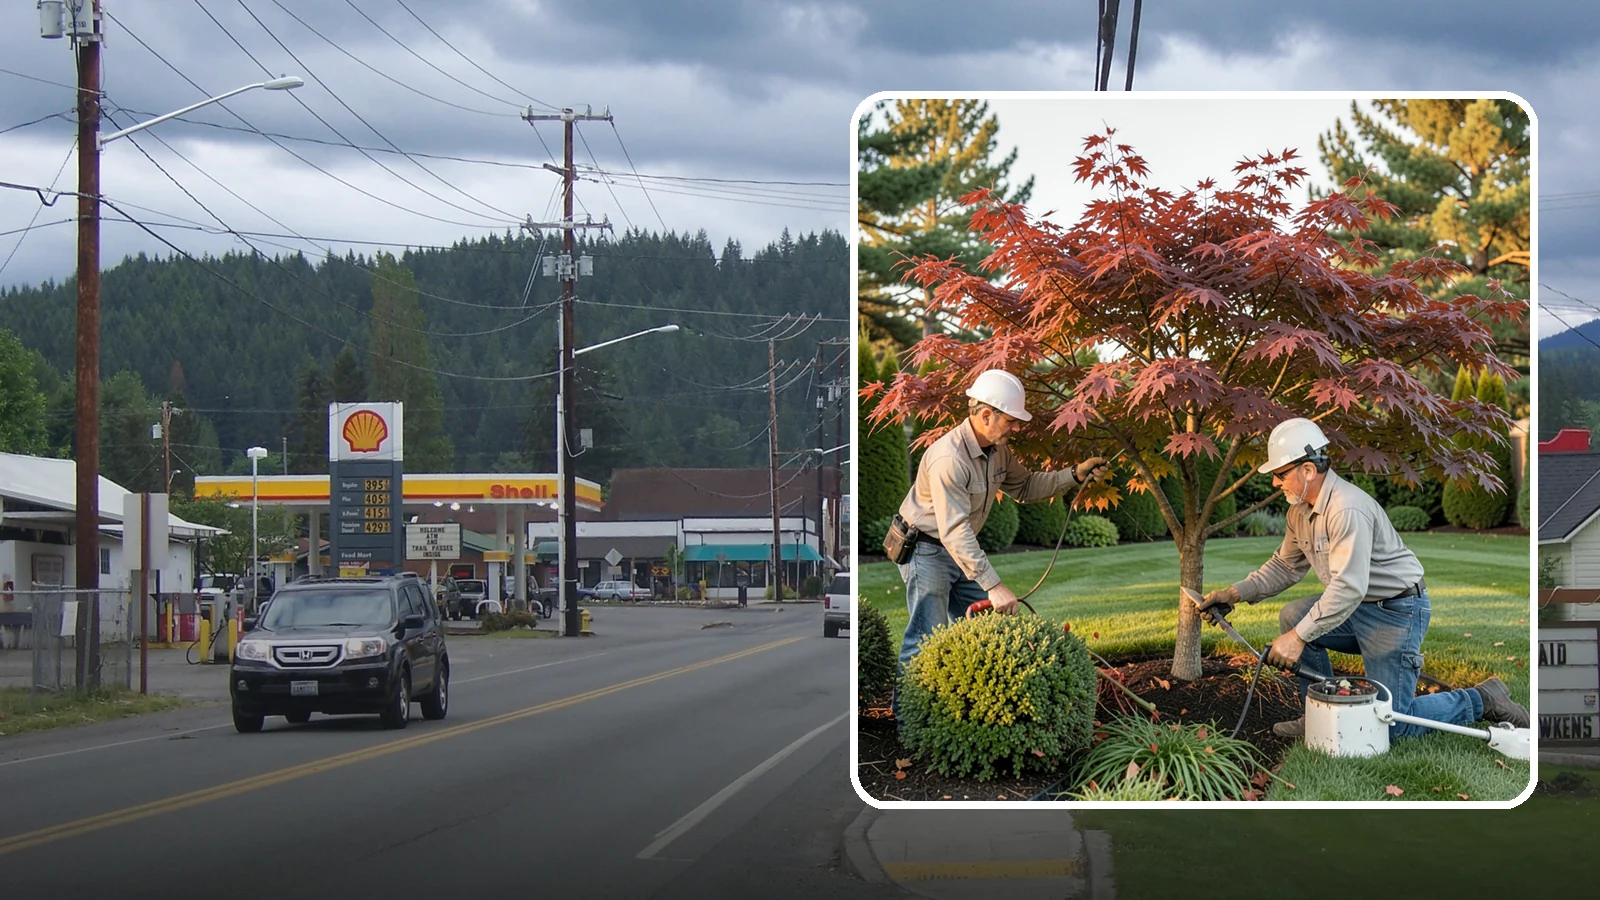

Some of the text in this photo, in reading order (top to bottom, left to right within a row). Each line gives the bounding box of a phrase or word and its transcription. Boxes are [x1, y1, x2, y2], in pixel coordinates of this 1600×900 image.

[366, 480, 383, 490] 395
[490, 484, 547, 499] Shell
[366, 494, 383, 504] 405
[366, 508, 383, 517] 415
[366, 522, 383, 532] 429
